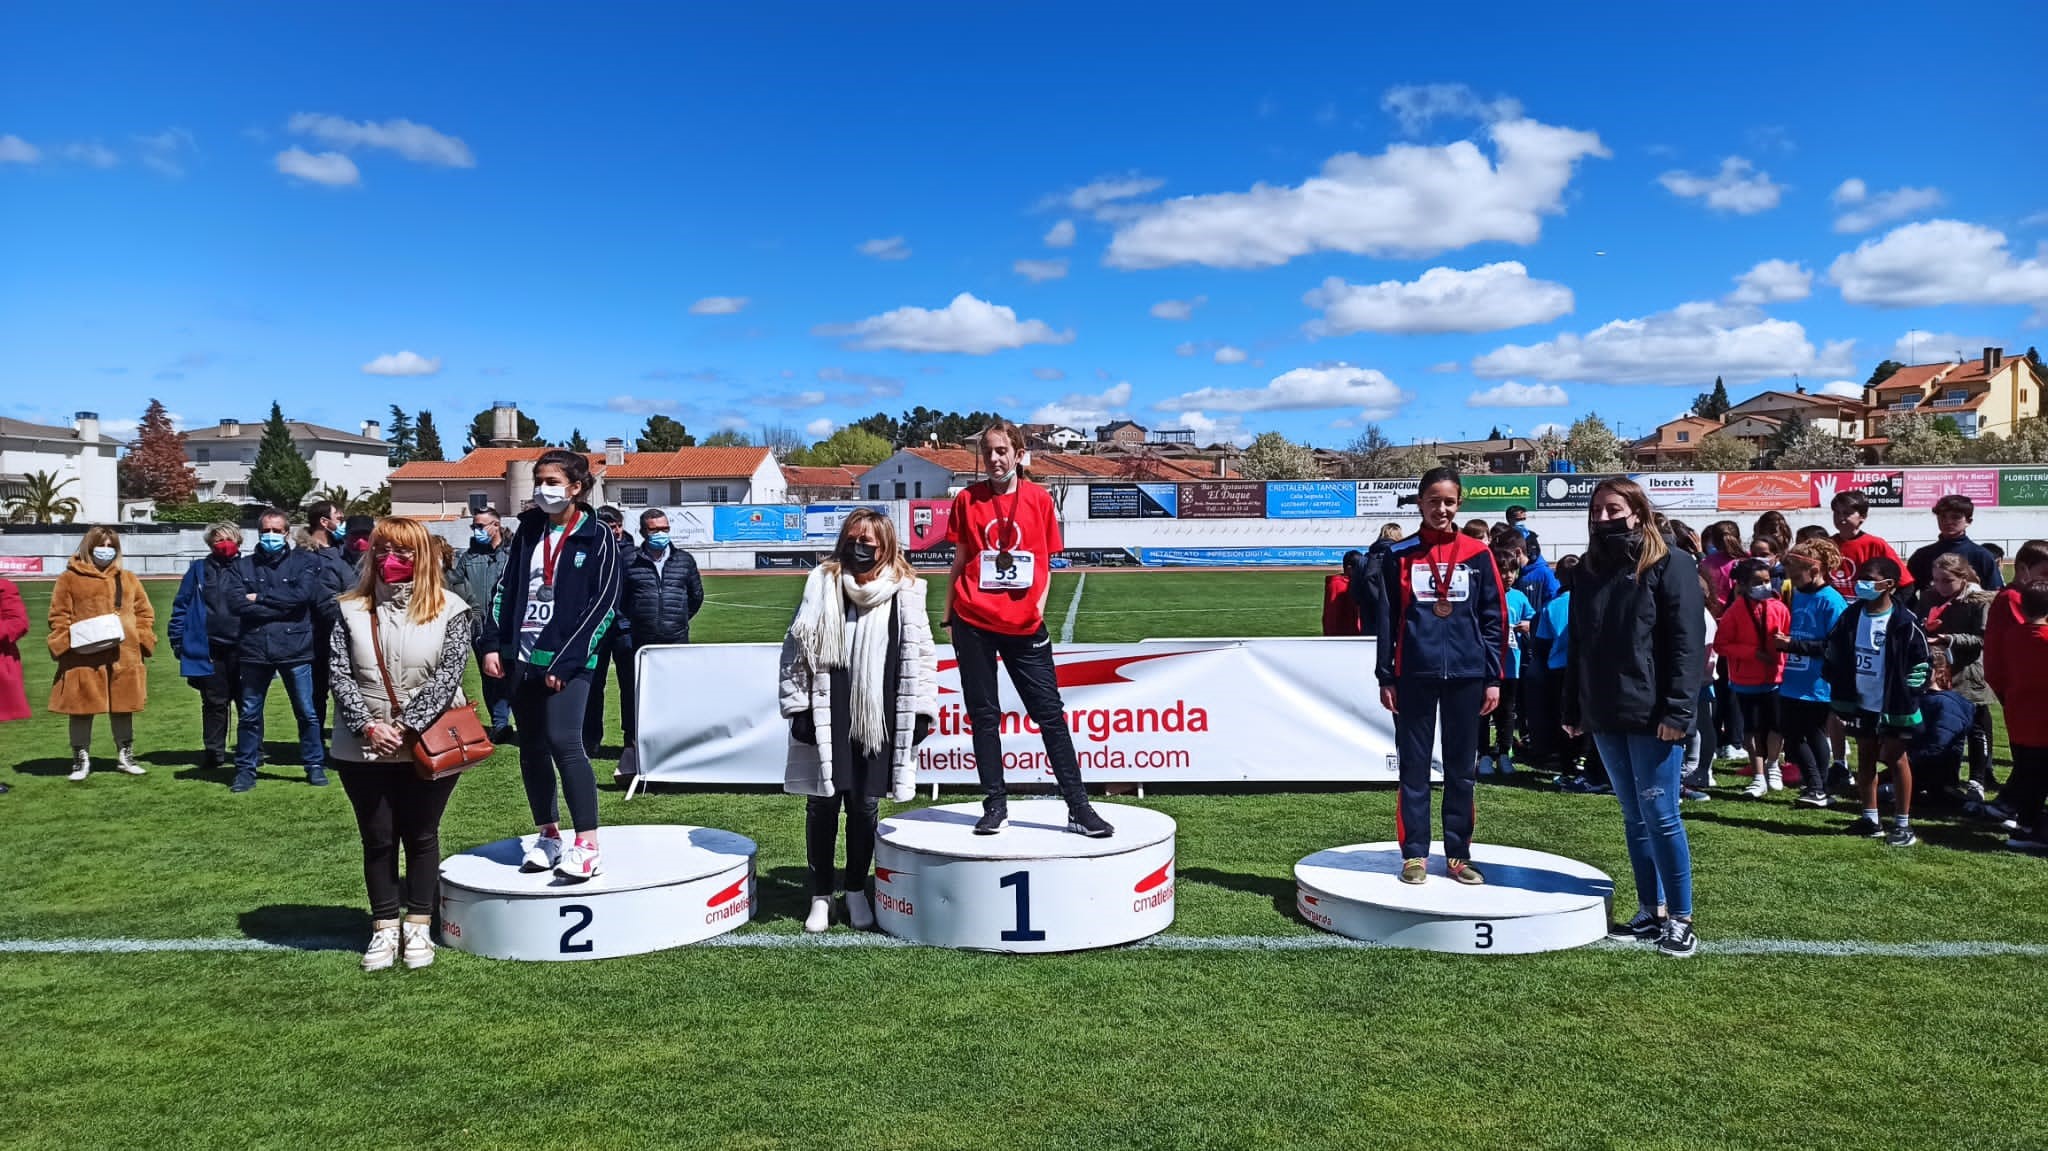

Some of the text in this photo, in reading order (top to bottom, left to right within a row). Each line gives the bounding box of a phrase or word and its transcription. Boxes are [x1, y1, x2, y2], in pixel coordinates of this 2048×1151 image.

[1649, 478, 1695, 487] Iberext
[1852, 473, 1888, 482] JUEGA
[1358, 482, 1370, 490] LA
[1470, 486, 1530, 496] AGUILAR
[1207, 490, 1251, 502] El Duque
[995, 565, 1017, 580] 53
[528, 604, 551, 620] 20
[928, 700, 1208, 742] tisorganda
[1000, 871, 1046, 942] 1
[559, 905, 594, 954] 2
[1474, 922, 1494, 949] 3
